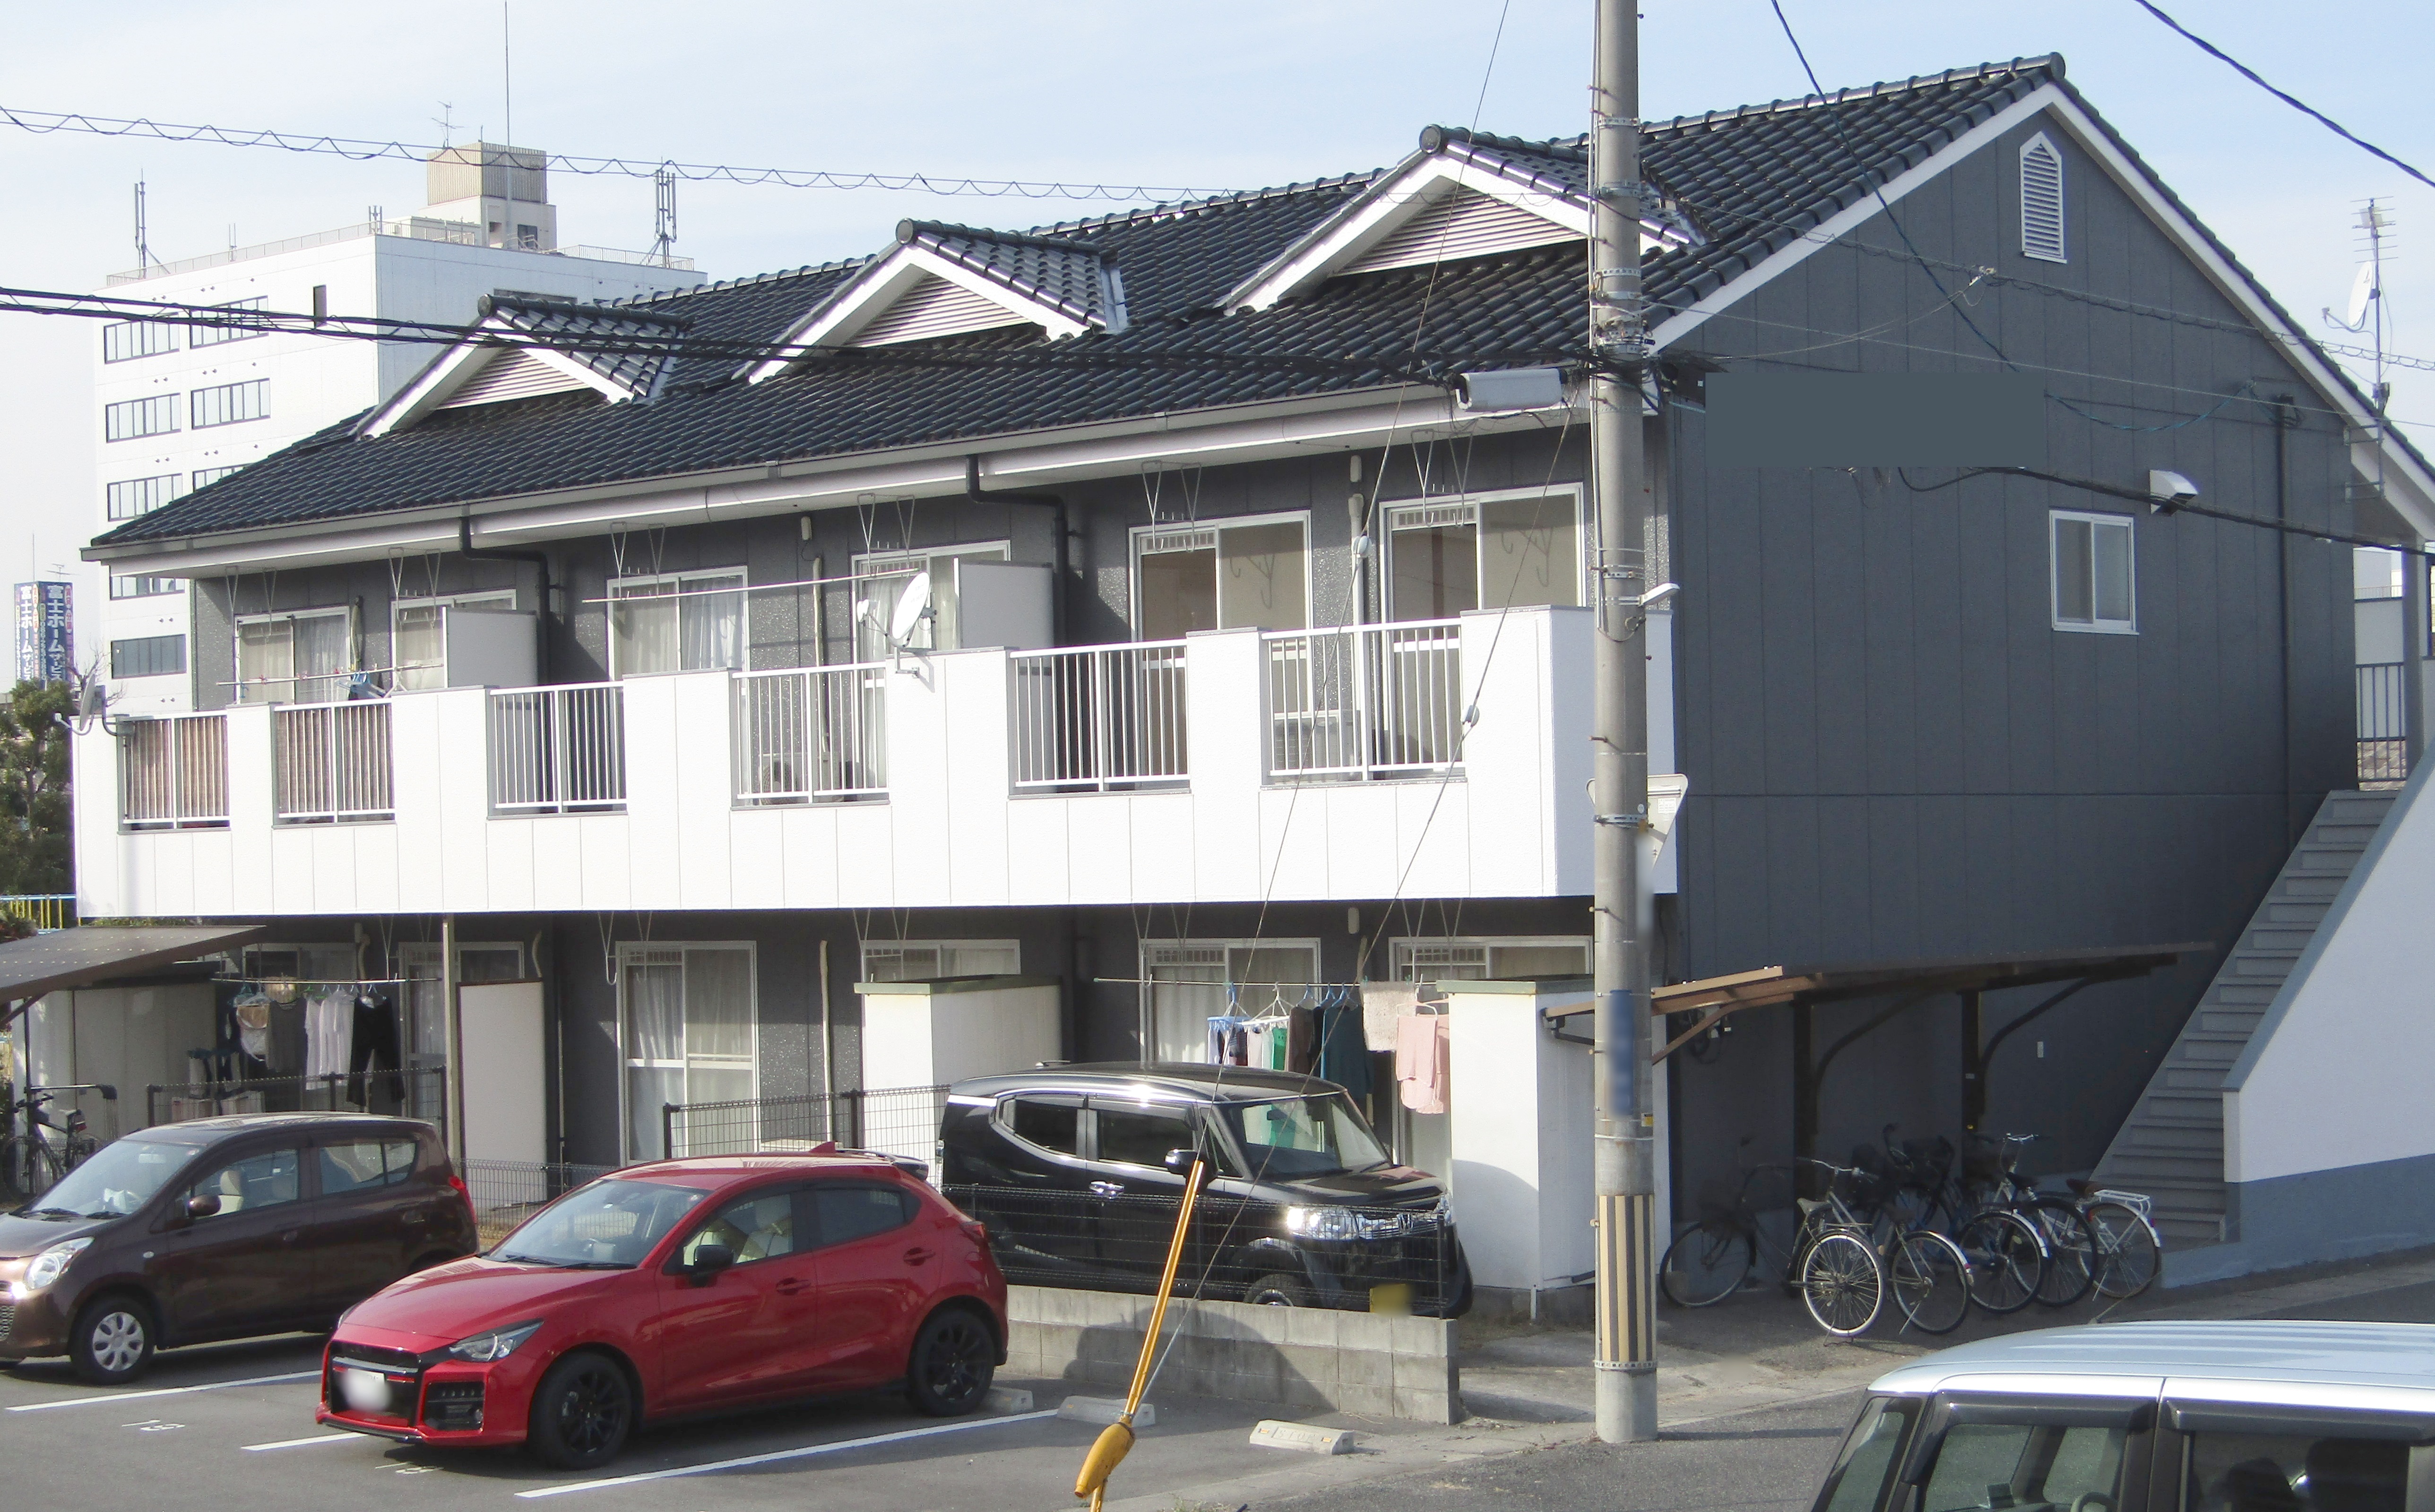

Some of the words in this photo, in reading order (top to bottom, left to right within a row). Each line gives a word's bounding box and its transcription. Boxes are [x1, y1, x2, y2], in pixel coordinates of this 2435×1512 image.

[21, 585, 33, 680] 富士ホームサービス
[47, 584, 65, 680] 富士ホームサービス
[1278, 1429, 1318, 1443] STOP
